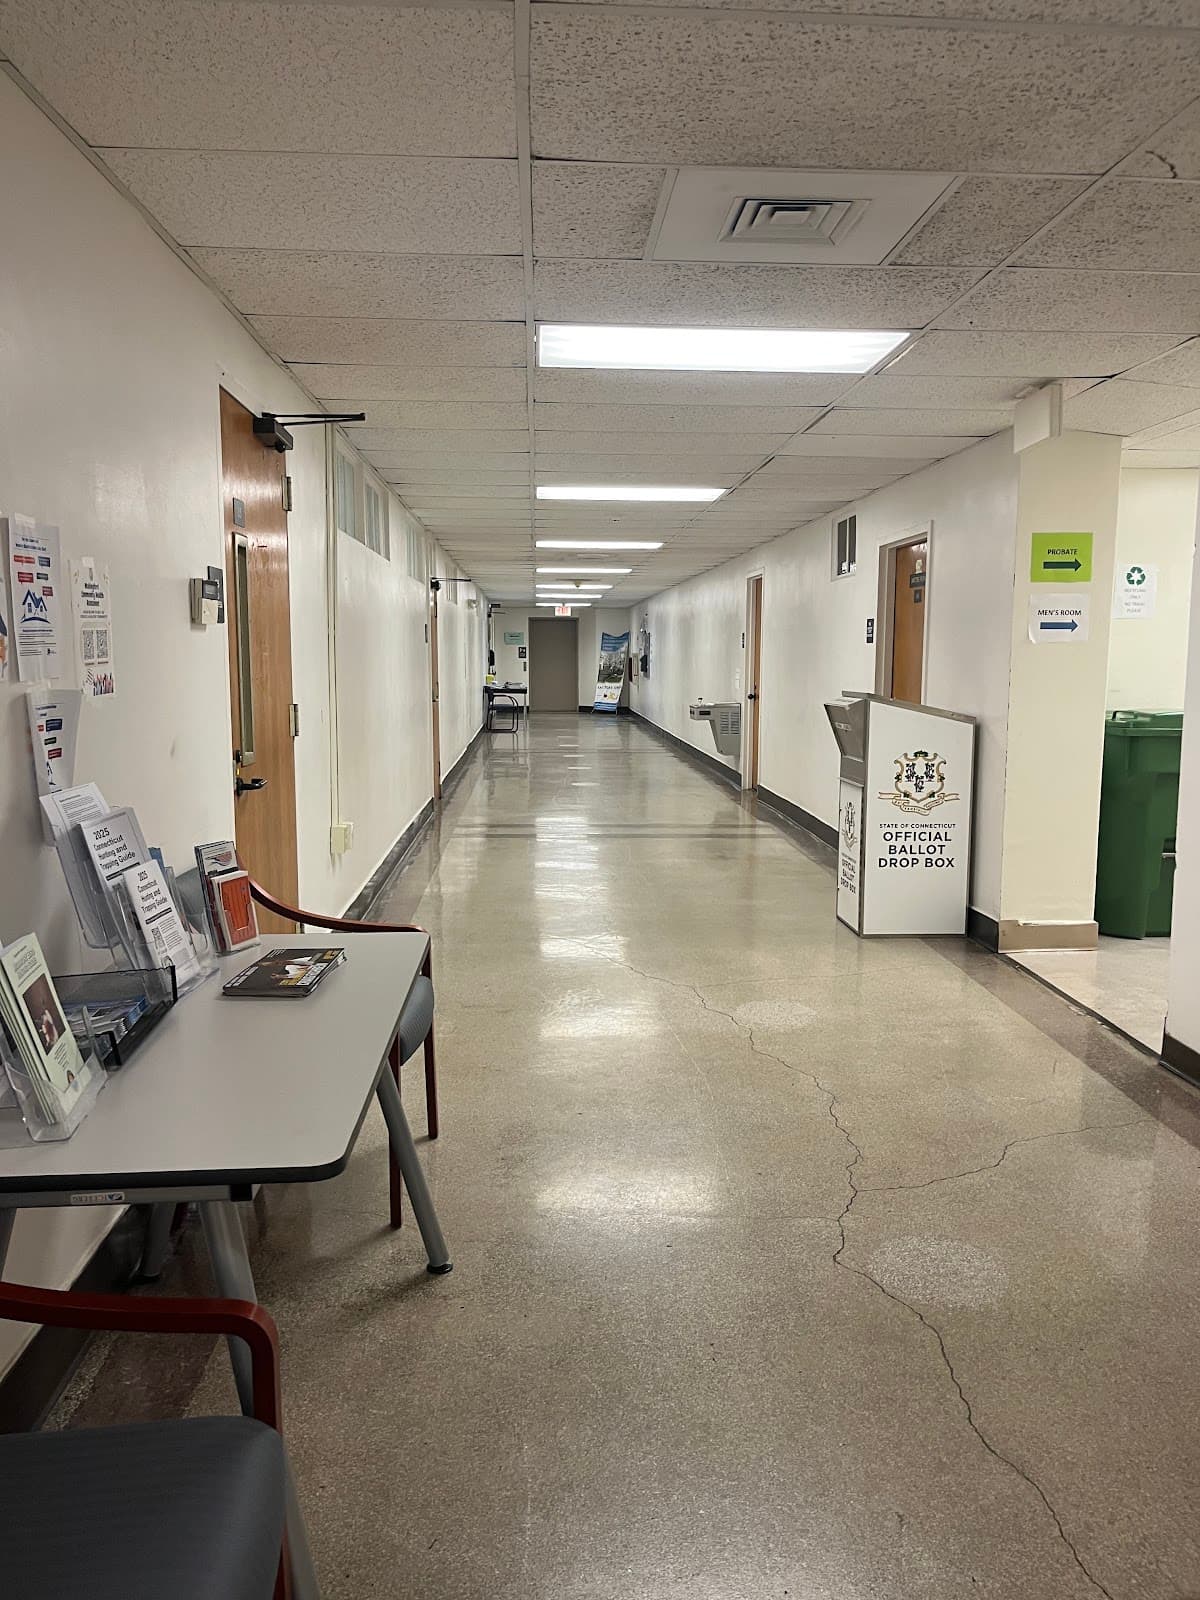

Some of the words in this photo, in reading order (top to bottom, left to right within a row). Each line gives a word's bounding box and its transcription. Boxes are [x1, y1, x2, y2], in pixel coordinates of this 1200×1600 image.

[1047, 548, 1078, 556] PROBATE
[93, 827, 110, 840] 2025
[883, 831, 952, 842] OFFICIAL
[93, 834, 124, 851] Connecticut
[115, 842, 128, 854] and
[888, 844, 946, 855] BALLOT
[117, 851, 136, 863] Guide
[878, 857, 919, 868] DROP
[924, 857, 955, 868] BOX
[137, 870, 148, 882] 2025
[137, 879, 158, 893] Connecticut
[141, 902, 157, 914] Trapping
[155, 896, 168, 907] Guide
